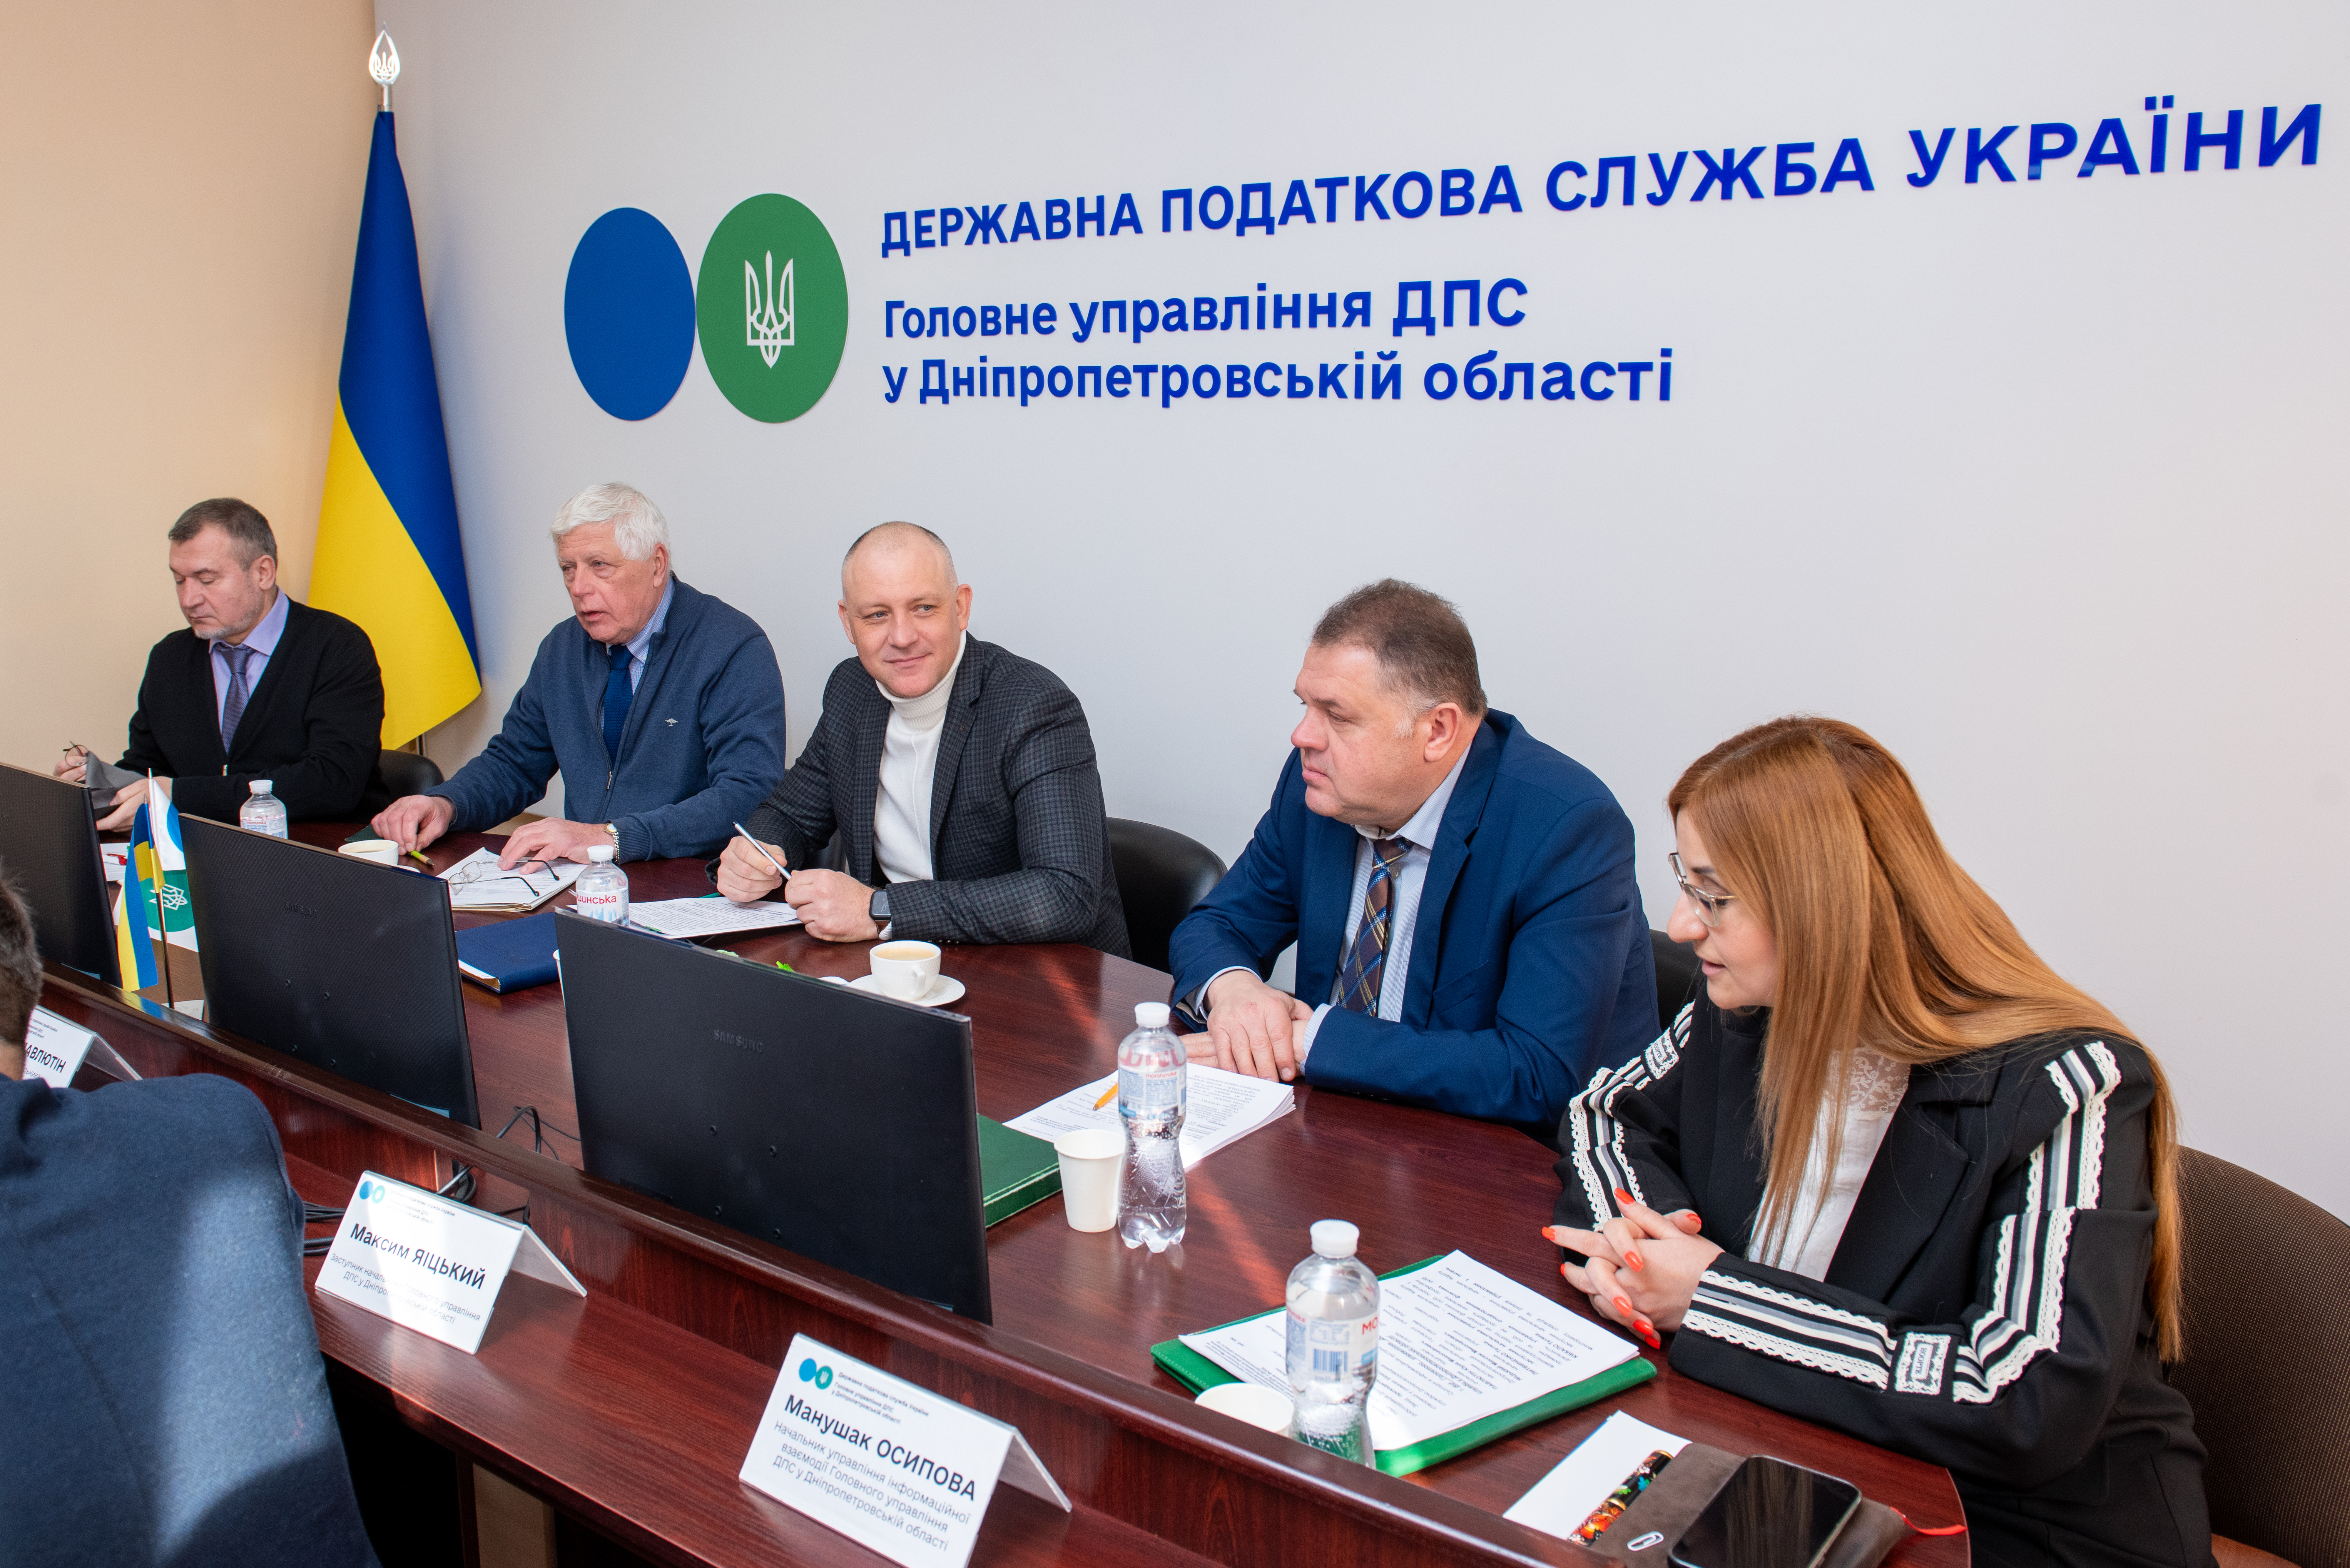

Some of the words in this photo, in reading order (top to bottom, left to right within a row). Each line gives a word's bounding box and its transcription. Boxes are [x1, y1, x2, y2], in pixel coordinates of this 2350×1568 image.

[882, 193, 1143, 257] ДЕРЖАВНА
[1162, 165, 1523, 236] ПОДАТКОВА
[1547, 138, 1875, 211] СЛУЖБА
[1907, 95, 2322, 187] УКРАЇНИ
[886, 300, 1057, 337] Головне
[1069, 282, 1371, 343] управління
[1393, 278, 1528, 336] ДПС
[883, 366, 908, 402] у
[919, 351, 1401, 408] Дніпропетровській
[1424, 348, 1673, 401] області
[577, 895, 617, 904] шинська
[440, 1207, 455, 1217] України
[330, 1253, 364, 1273] Заступник
[440, 1301, 480, 1321] управління
[350, 1223, 409, 1258] Максим
[412, 1249, 485, 1289] ЯІЦЬКИЙ
[343, 1271, 359, 1283] ДПС
[357, 1278, 364, 1287] у
[429, 1308, 456, 1324] області
[1915, 1348, 1927, 1374] HOOPTE
[834, 1382, 854, 1394] Головне
[854, 1393, 881, 1407] управління
[882, 1404, 893, 1413] ДПС
[835, 1391, 881, 1415] Дніпропетровській
[882, 1413, 901, 1424] області
[838, 1372, 862, 1386] Державна
[863, 1384, 888, 1398] податкова
[889, 1396, 908, 1407] служба
[909, 1404, 929, 1416] України
[775, 1421, 825, 1453] Начальник
[827, 1449, 885, 1482] управління
[888, 1479, 969, 1523] інформаційної
[785, 1395, 871, 1449] Манушак
[877, 1439, 974, 1500] ОСИПОВА
[773, 1455, 795, 1473] ДПС
[796, 1469, 803, 1479] у
[804, 1472, 908, 1527] Дніпропетровській
[906, 1525, 947, 1550] області
[779, 1444, 828, 1471] взаємодії
[830, 1466, 883, 1500] Головного
[885, 1497, 947, 1531] управління
